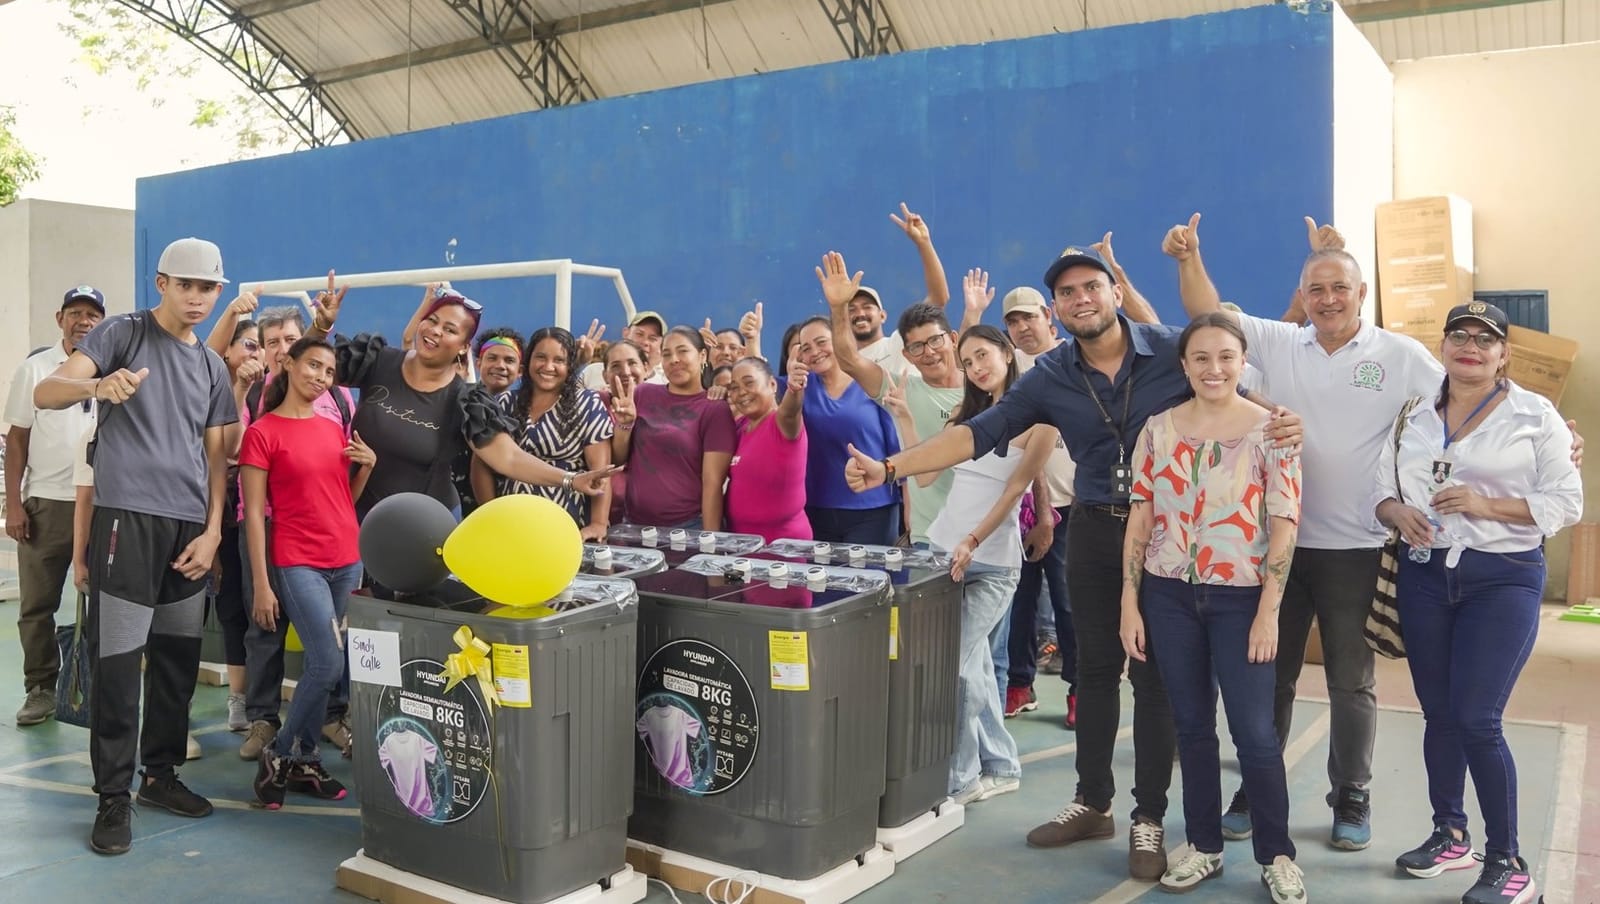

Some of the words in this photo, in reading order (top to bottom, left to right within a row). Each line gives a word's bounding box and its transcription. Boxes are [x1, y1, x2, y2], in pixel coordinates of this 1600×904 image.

[360, 656, 381, 671] Calle
[683, 649, 715, 664] HYUNDAI
[416, 670, 447, 684] HYUNDAI
[664, 667, 688, 678] LAVADORA
[400, 690, 423, 700] LAVADORA
[701, 685, 732, 706] 8KG
[436, 706, 465, 728] 8KG
